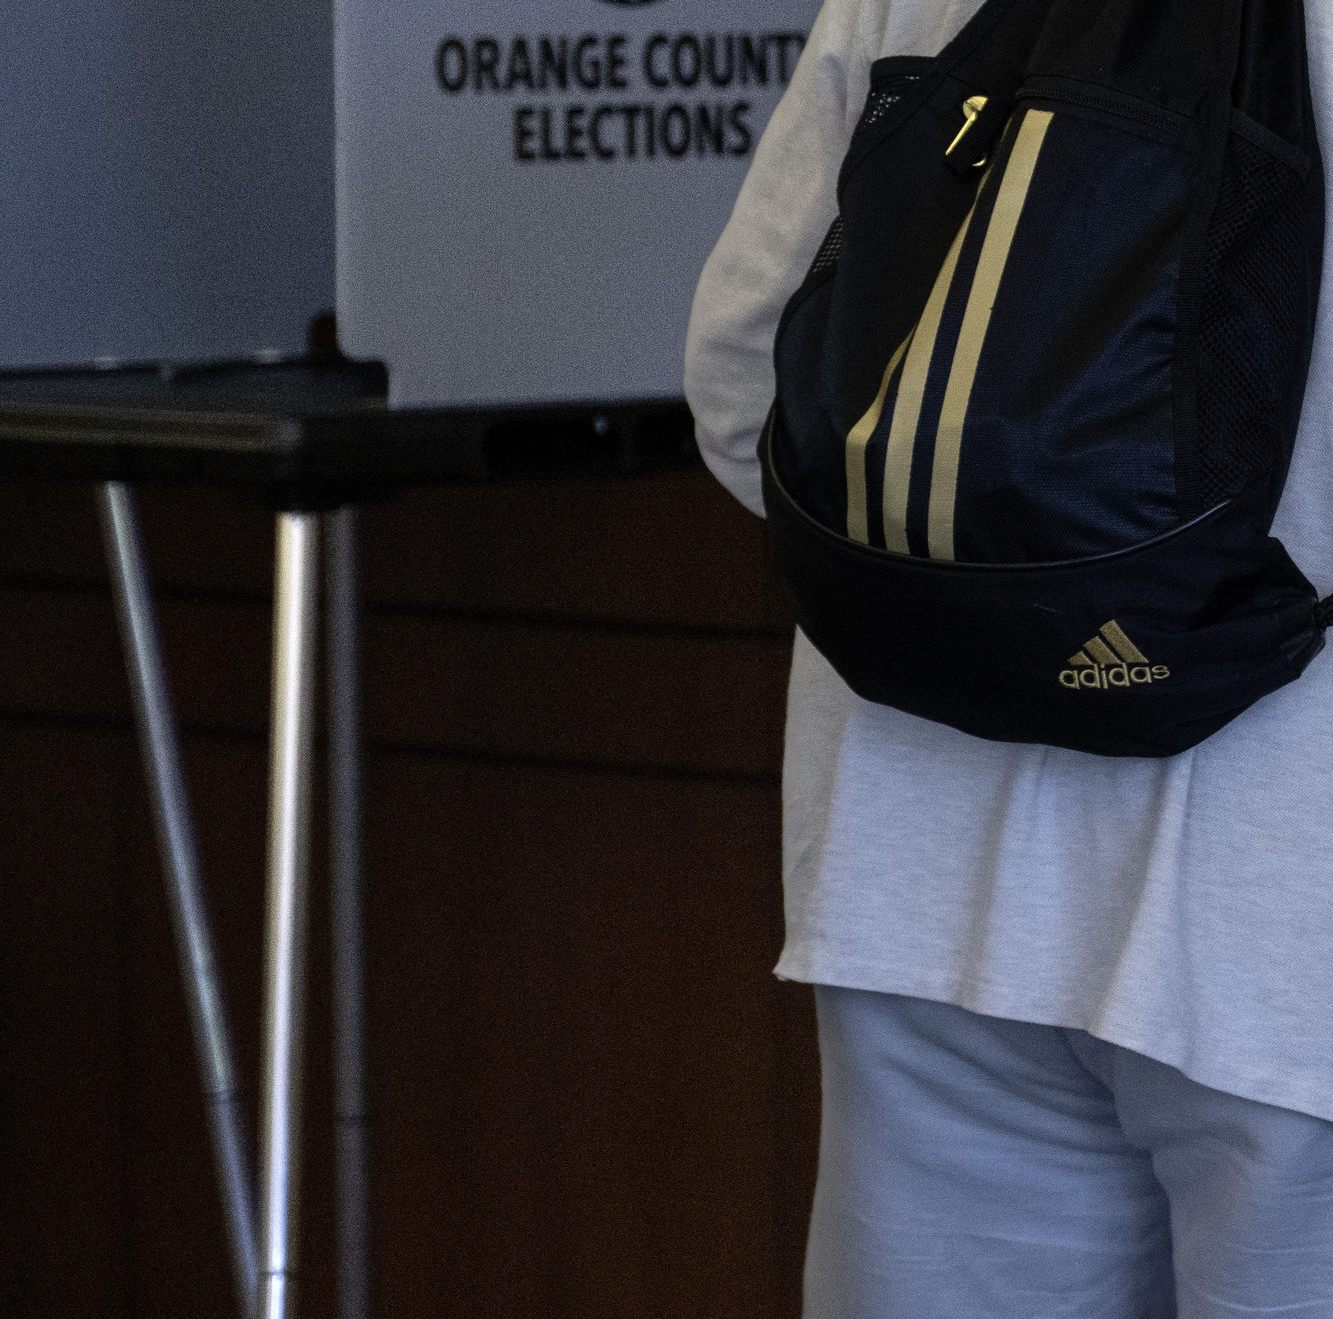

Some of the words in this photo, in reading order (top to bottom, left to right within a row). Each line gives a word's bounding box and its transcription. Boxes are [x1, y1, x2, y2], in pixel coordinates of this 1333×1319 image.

[434, 35, 628, 93] ORANGE
[513, 101, 753, 163] ELECTIONS
[1058, 662, 1171, 690] adidas
